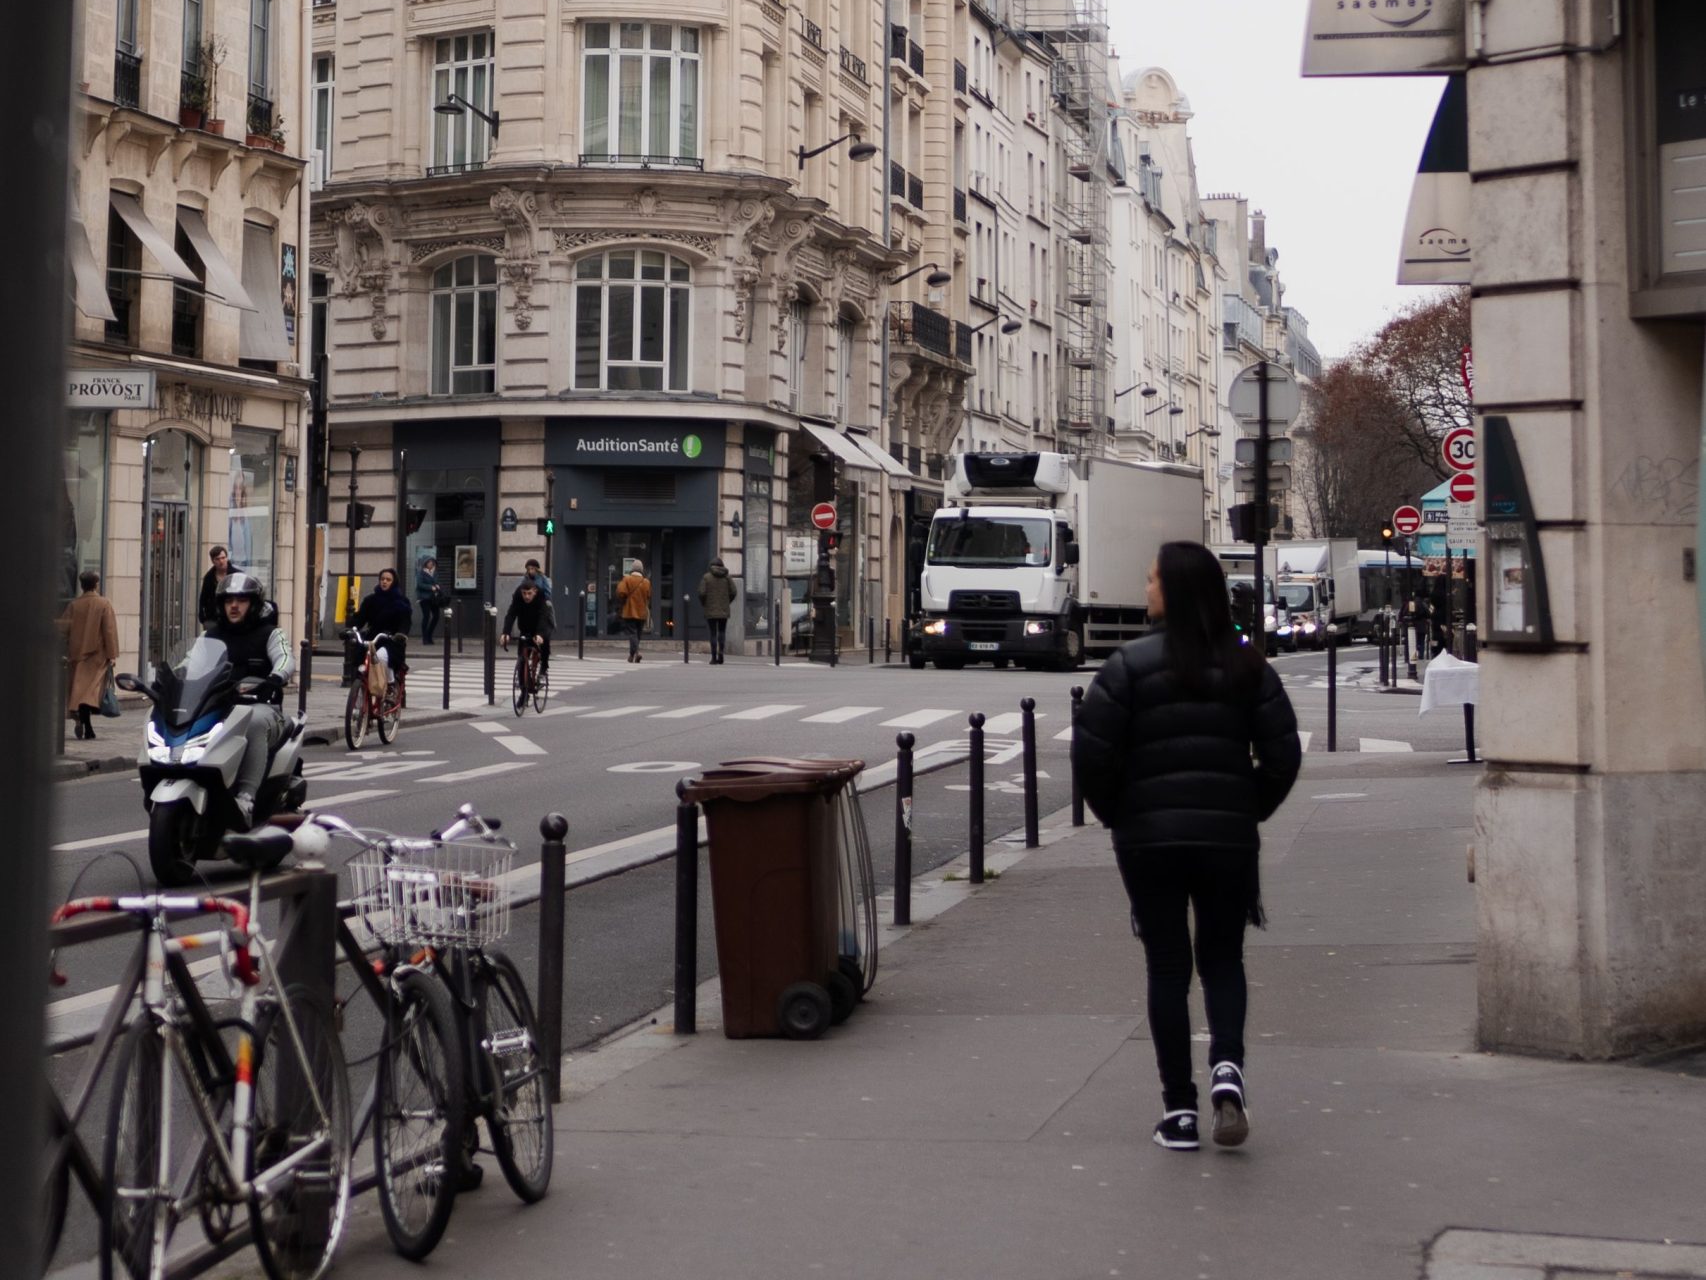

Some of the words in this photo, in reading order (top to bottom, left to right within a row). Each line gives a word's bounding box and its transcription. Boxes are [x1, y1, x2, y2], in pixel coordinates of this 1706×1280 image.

[68, 383, 144, 396] PROVOST
[576, 438, 679, 452] AuditionSanté
[1452, 441, 1475, 459] 30
